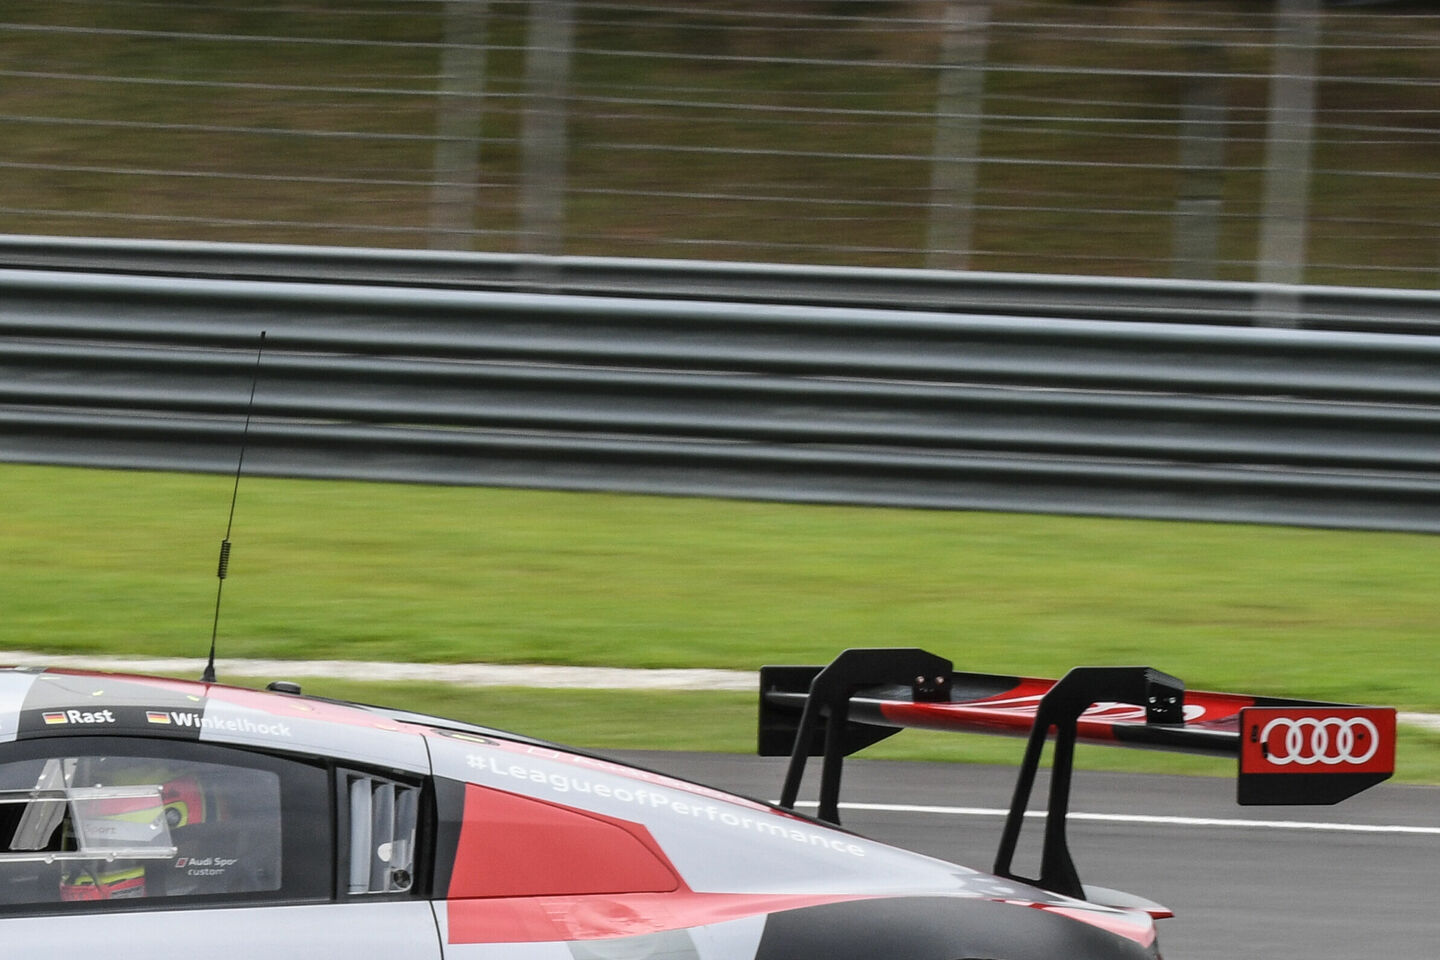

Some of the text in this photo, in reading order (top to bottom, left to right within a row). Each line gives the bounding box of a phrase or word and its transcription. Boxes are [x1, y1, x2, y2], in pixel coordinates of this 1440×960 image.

[67, 709, 115, 724] Rast
[171, 711, 291, 738] Winkelhock
[466, 752, 865, 857] #LeagueofPerformance
